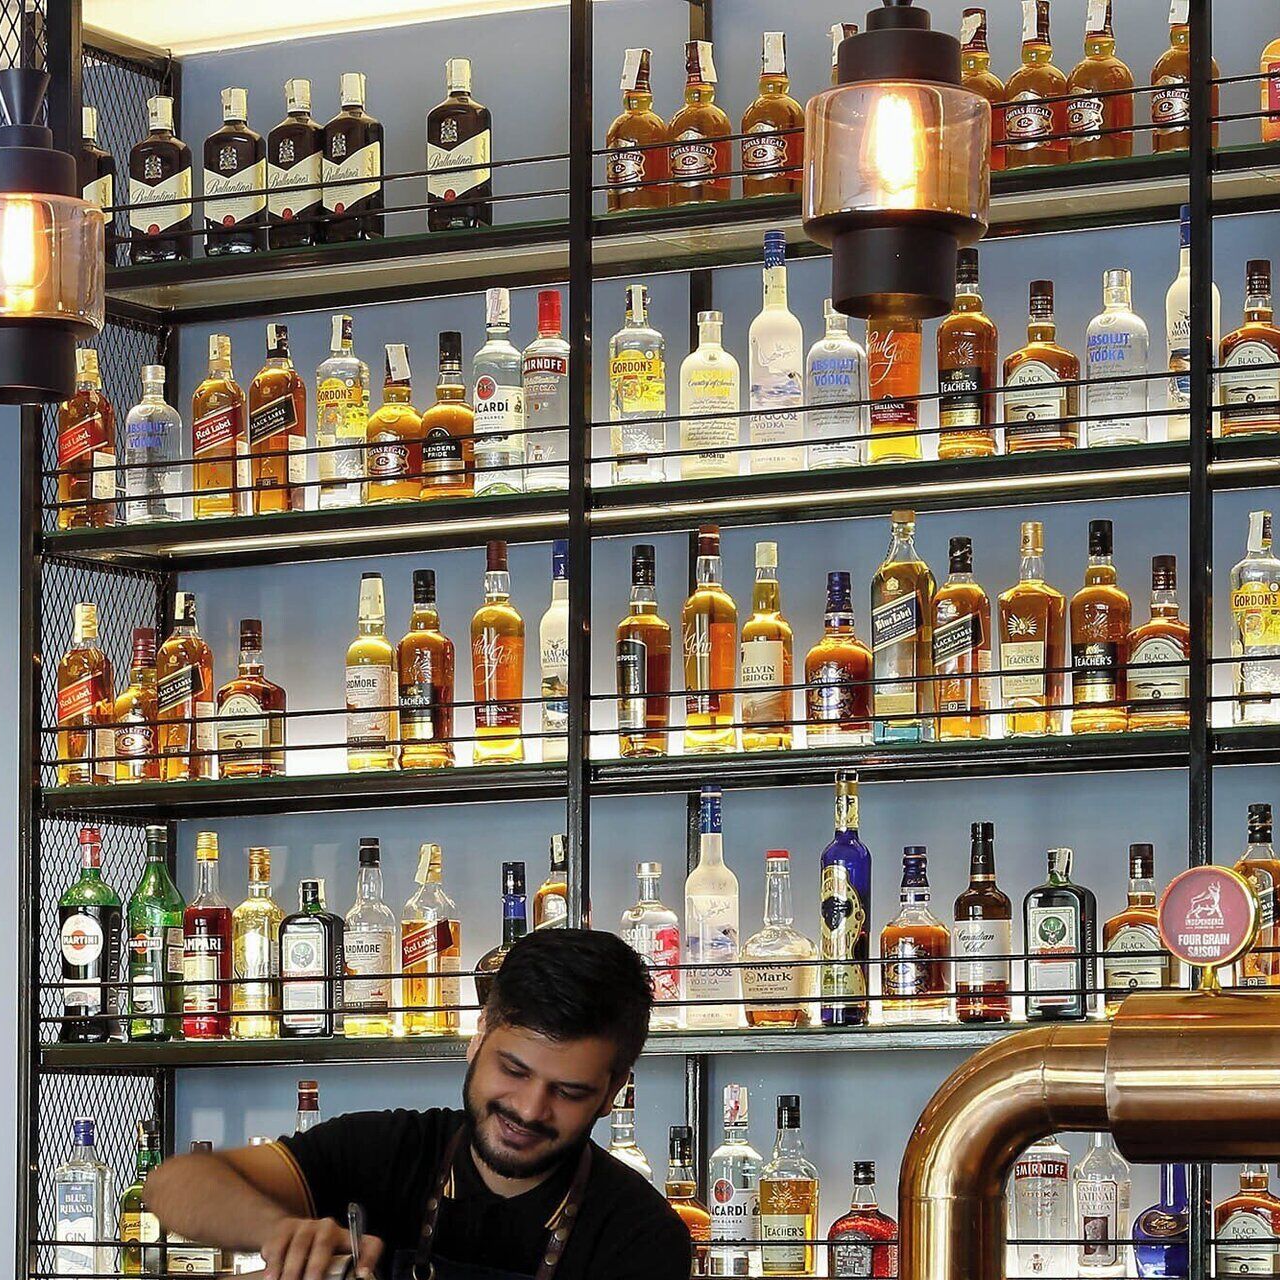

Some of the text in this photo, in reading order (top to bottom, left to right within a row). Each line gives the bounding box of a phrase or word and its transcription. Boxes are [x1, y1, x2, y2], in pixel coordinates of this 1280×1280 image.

[1087, 332, 1131, 346] ABSOLUT
[1089, 351, 1125, 363] VODKA
[1237, 356, 1263, 365] BLACK
[612, 361, 653, 373] GORDON'S
[811, 358, 855, 372] ABSOLUT
[814, 374, 851, 387] VODKA
[1018, 374, 1043, 383] BLACK
[940, 380, 978, 394] TEACHER'S
[195, 420, 232, 441] Red Label
[427, 450, 448, 458] PRIDE
[1234, 593, 1277, 607] GORDON'S
[891, 607, 912, 624] Label
[953, 627, 972, 641] LABEL
[1005, 652, 1039, 666] TEACHER'S
[1074, 654, 1112, 668] TEACHER'S
[1143, 652, 1169, 662] BLACK
[174, 677, 193, 691] LABEL
[73, 689, 91, 702] Label
[1185, 917, 1224, 926] INDEPENDENCE
[63, 936, 98, 945] MARTINI
[957, 927, 995, 943] Canadian
[1178, 932, 1230, 945] FOUR GRAIN
[129, 938, 161, 949] MARTINI
[404, 936, 437, 956] Red Label
[963, 942, 984, 954] Club
[1120, 941, 1145, 950] BLACK
[1187, 945, 1221, 957] SAISON
[757, 972, 793, 983] Mark
[1015, 1163, 1066, 1178] SMIRNOFF
[64, 1192, 87, 1204] BLUE
[59, 1203, 94, 1214] RIBAND
[64, 1231, 87, 1242] GIN
[763, 1224, 805, 1239] TEACHER'S
[1231, 1227, 1258, 1236] BLACK
